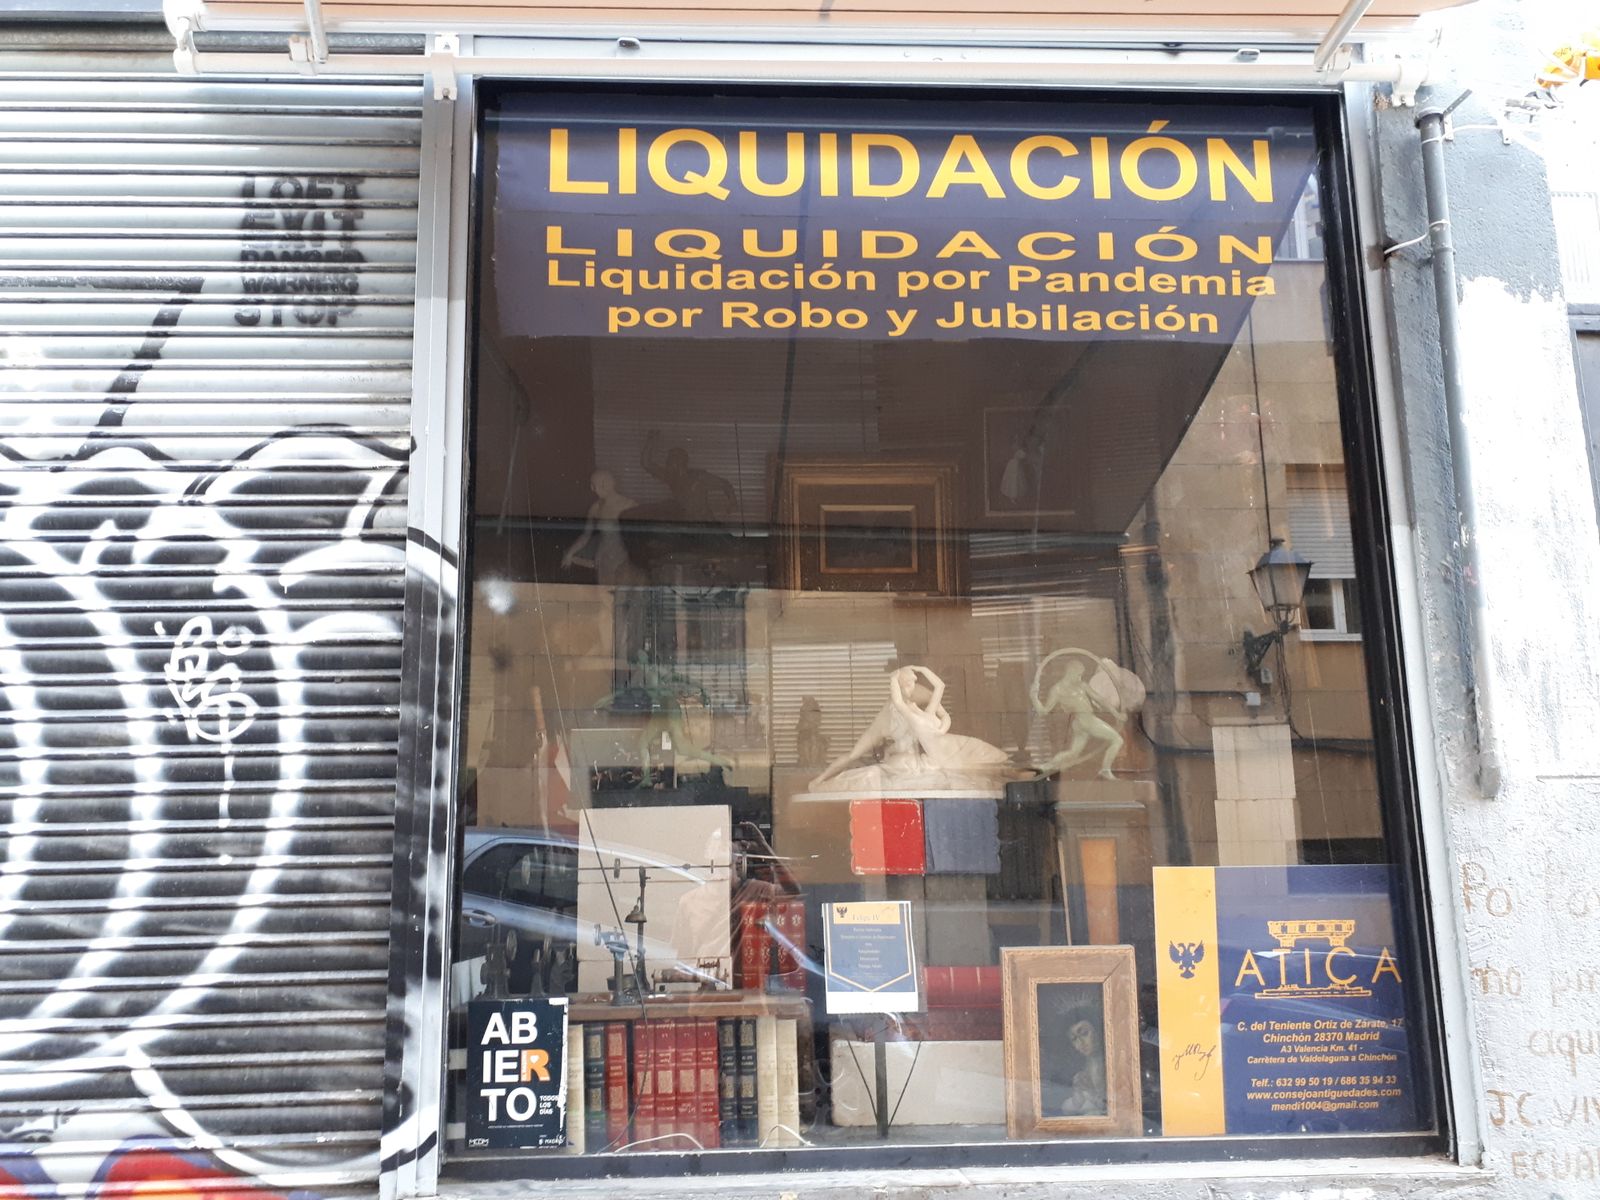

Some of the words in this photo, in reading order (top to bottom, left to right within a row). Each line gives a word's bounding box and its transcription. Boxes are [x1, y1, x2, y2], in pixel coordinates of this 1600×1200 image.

[548, 119, 1274, 203] LIQUIDACIÓN
[546, 225, 1274, 264] LIQUIDACIÓN
[548, 260, 877, 295] Liquidación
[898, 266, 990, 298] por
[1007, 264, 1277, 298] Pandemia
[607, 303, 702, 333] por
[721, 300, 869, 330] Robo
[887, 309, 915, 337] y
[936, 300, 1220, 334] Jubilación
[1234, 946, 1402, 986] ATICA
[1237, 1021, 1247, 1031] C.
[1250, 1021, 1265, 1031] del
[1269, 1020, 1311, 1031] Teniente
[1314, 1019, 1337, 1030] Ortiz
[1340, 1019, 1352, 1029] de
[1263, 1032, 1311, 1043] Chinchón
[1314, 1032, 1342, 1042] 28370
[1345, 1031, 1380, 1041] Madrid
[1280, 1045, 1292, 1053] A3
[1294, 1044, 1329, 1053] Valencia
[1330, 1044, 1346, 1052] Km.
[1287, 1055, 1297, 1063] de
[1299, 1054, 1349, 1064] Valdelaguna
[1358, 1053, 1397, 1062] Chinchón
[1276, 1078, 1293, 1087] 632
[1295, 1078, 1306, 1086] 99
[1308, 1077, 1320, 1086] 50
[1322, 1077, 1333, 1086] 19
[1340, 1076, 1357, 1085] 686
[1359, 1076, 1370, 1085] 35
[1372, 1075, 1383, 1085] 94
[1385, 1075, 1397, 1084] 33
[1247, 1087, 1401, 1100] www.consejoantiguedades.com
[1271, 1100, 1379, 1112] mendi1004@gmail.com
